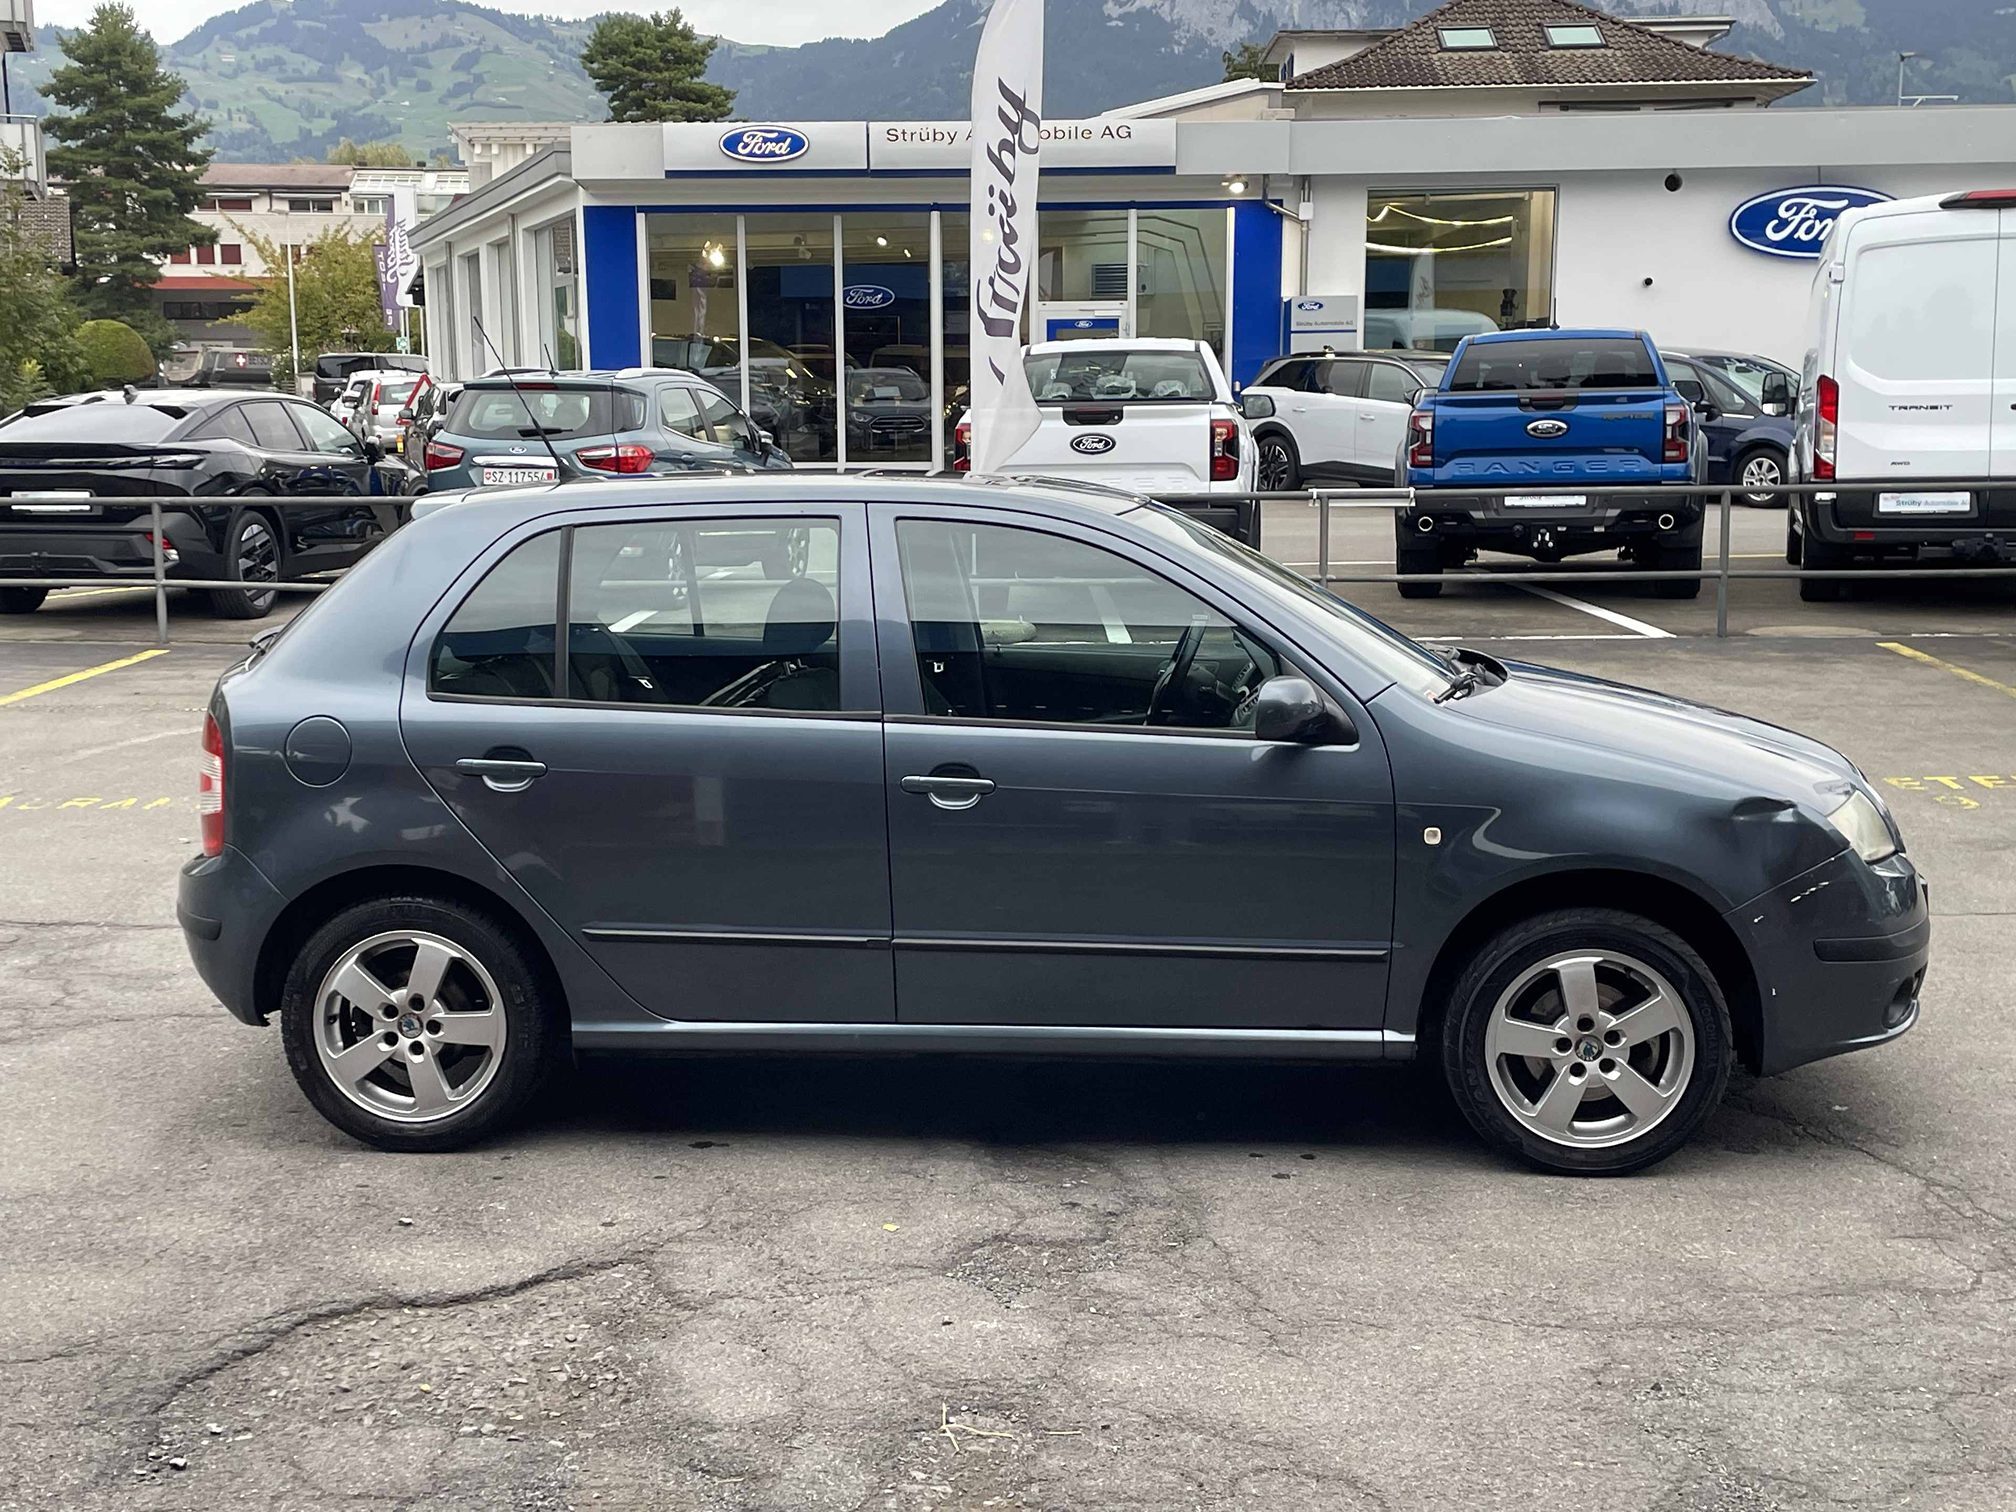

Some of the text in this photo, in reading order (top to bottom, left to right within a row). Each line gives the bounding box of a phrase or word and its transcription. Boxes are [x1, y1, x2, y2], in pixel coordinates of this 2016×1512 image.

[737, 130, 791, 155] Ford
[886, 127, 958, 145] Strüby
[1100, 125, 1132, 139] AG
[846, 288, 883, 304] Ford
[1080, 437, 1105, 449] Ford
[1454, 459, 1641, 475] RANGER
